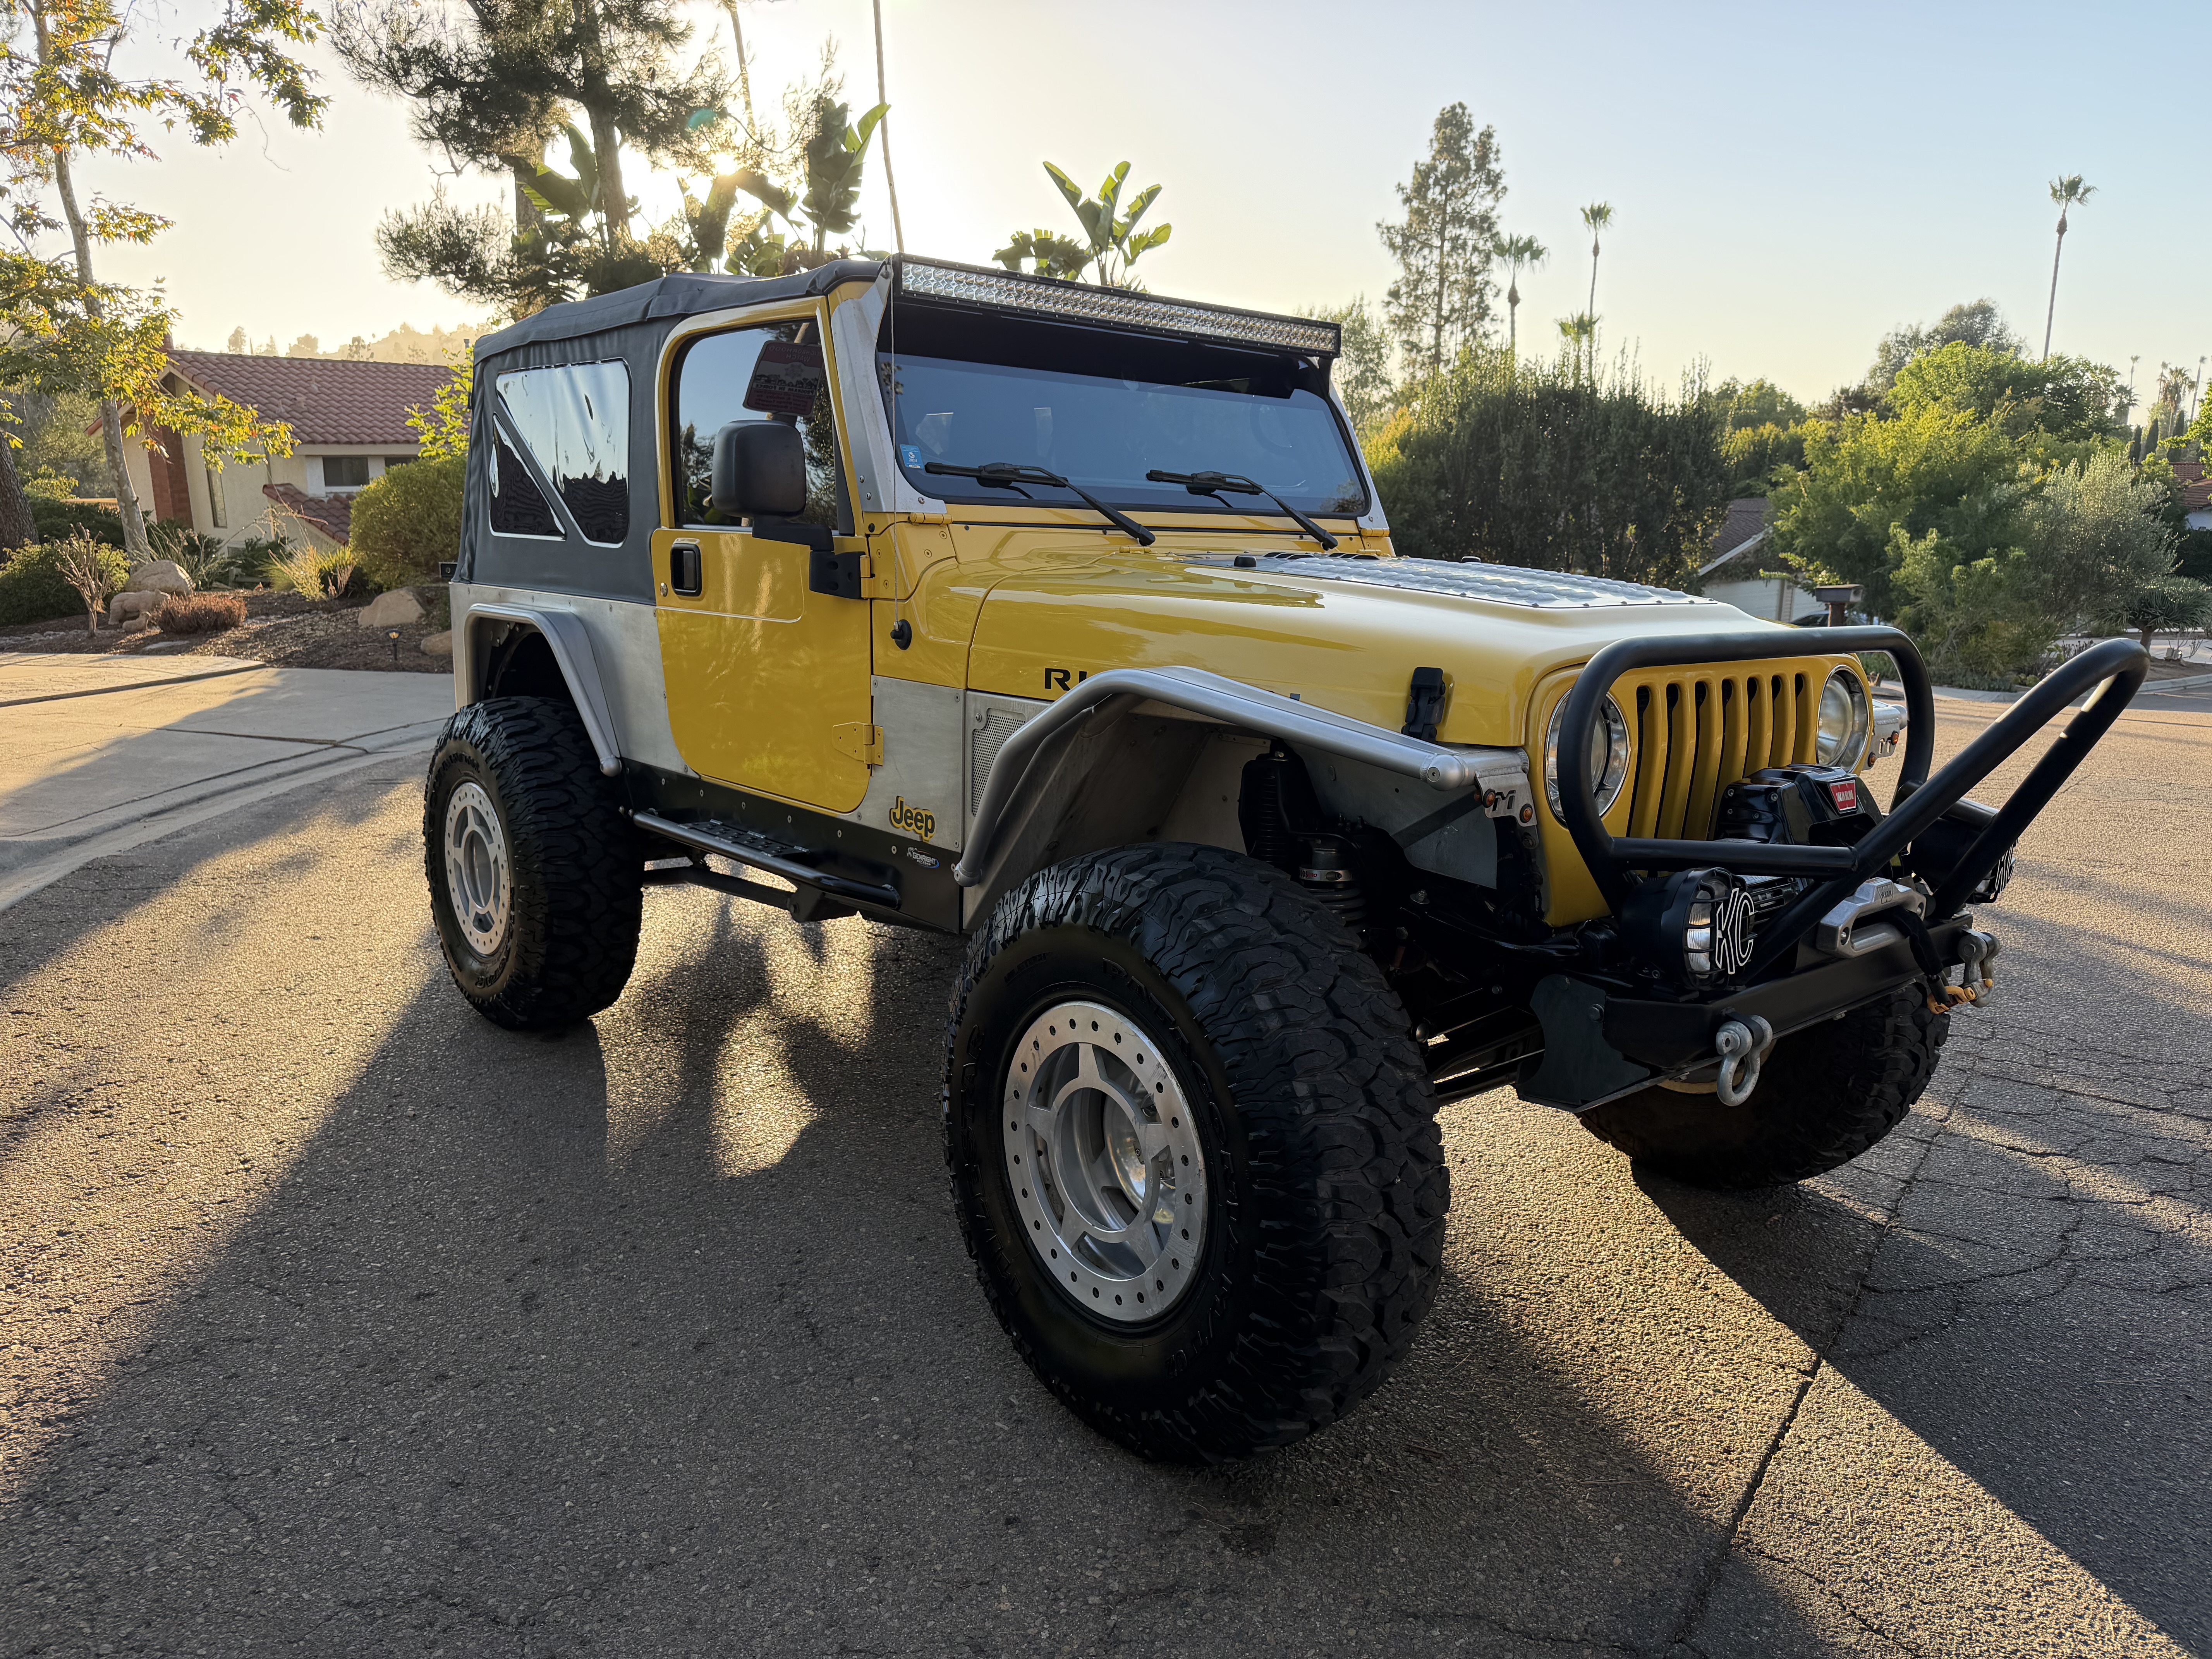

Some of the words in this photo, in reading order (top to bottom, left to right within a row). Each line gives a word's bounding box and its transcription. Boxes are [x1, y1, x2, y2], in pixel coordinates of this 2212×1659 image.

[1836, 790, 1854, 802] WARN
[892, 800, 935, 838] Jeep
[1881, 890, 1892, 899] WARN
[1715, 887, 1755, 975] KC
[960, 1024, 1022, 1298] MILESTAR
